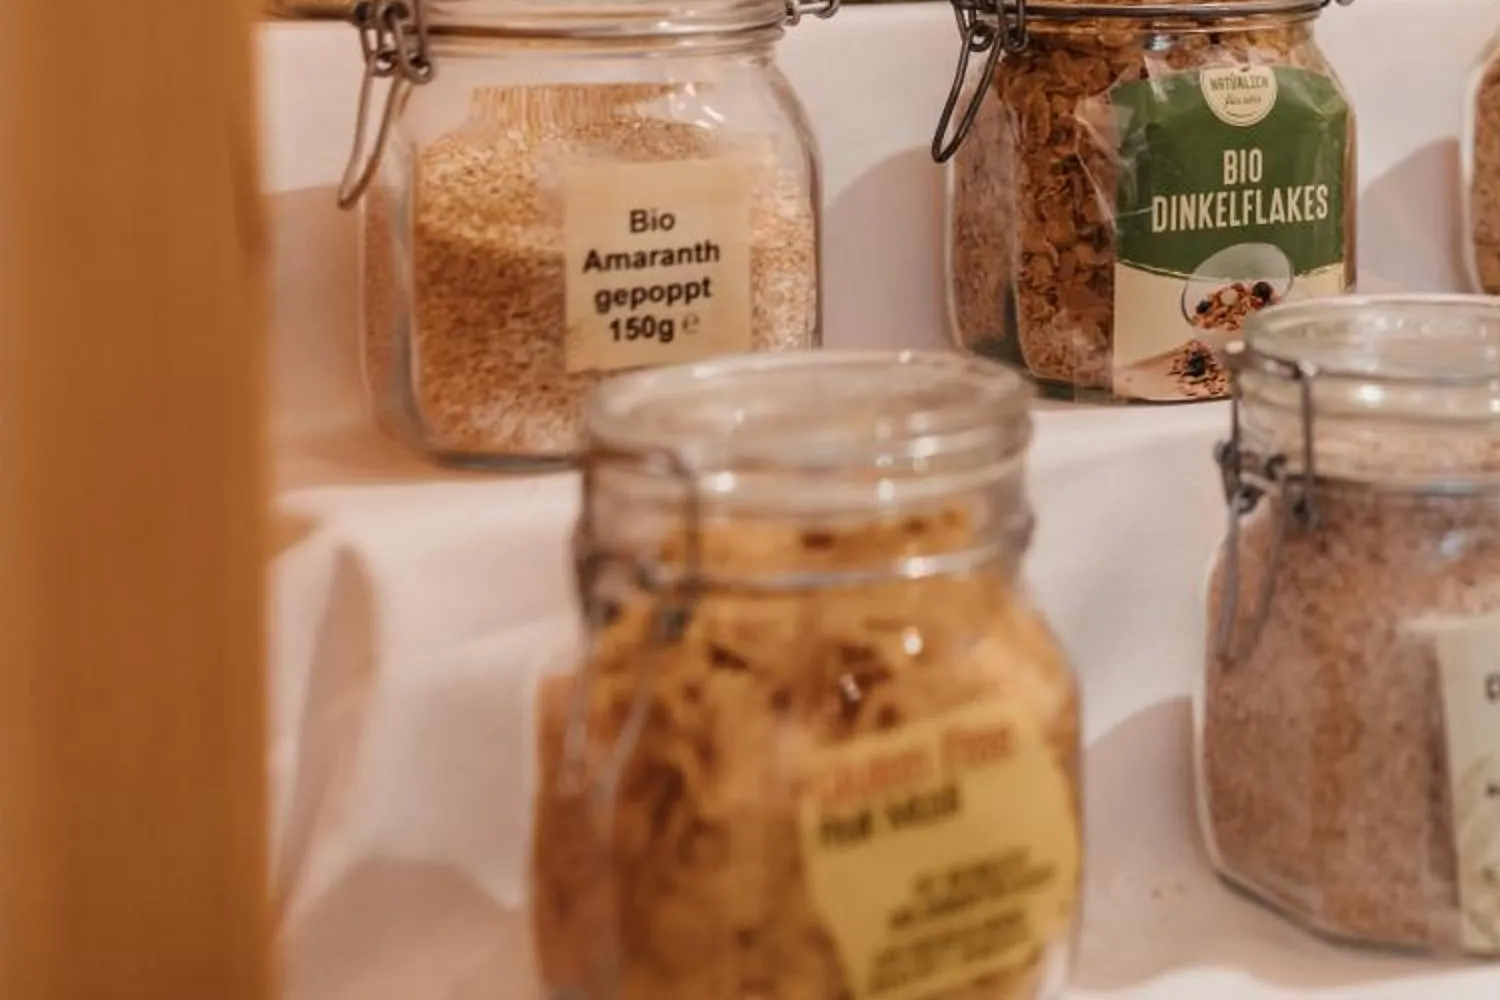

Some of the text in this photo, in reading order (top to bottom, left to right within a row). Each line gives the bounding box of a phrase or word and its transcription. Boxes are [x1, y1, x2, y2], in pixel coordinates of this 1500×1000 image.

[1223, 148, 1263, 185] BIO
[629, 208, 676, 234] Bio
[1151, 184, 1329, 233] DINKELFLAKES
[582, 240, 721, 275] Amaranth
[594, 276, 712, 315] gepoppt
[609, 314, 674, 344] 150g
